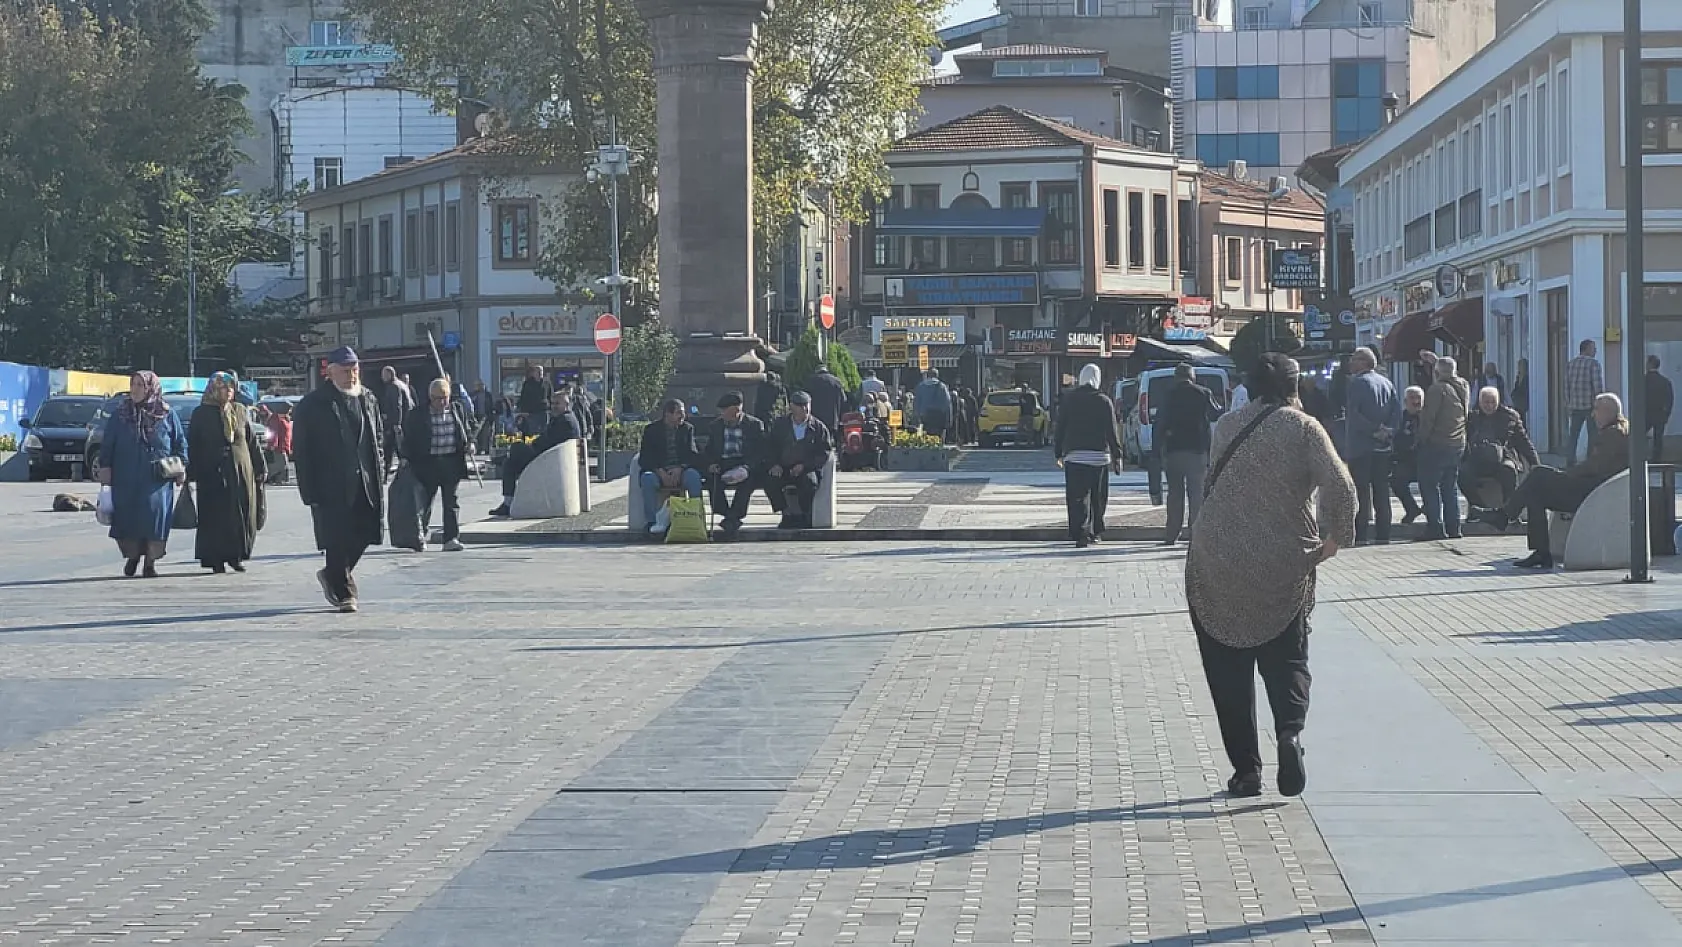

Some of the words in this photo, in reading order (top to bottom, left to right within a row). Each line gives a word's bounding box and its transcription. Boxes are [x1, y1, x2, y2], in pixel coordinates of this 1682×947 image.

[1279, 265, 1312, 273] KIYAK
[499, 312, 576, 330] ekomini
[885, 318, 951, 328] SAATHANE
[1008, 329, 1056, 340] SAATHANE
